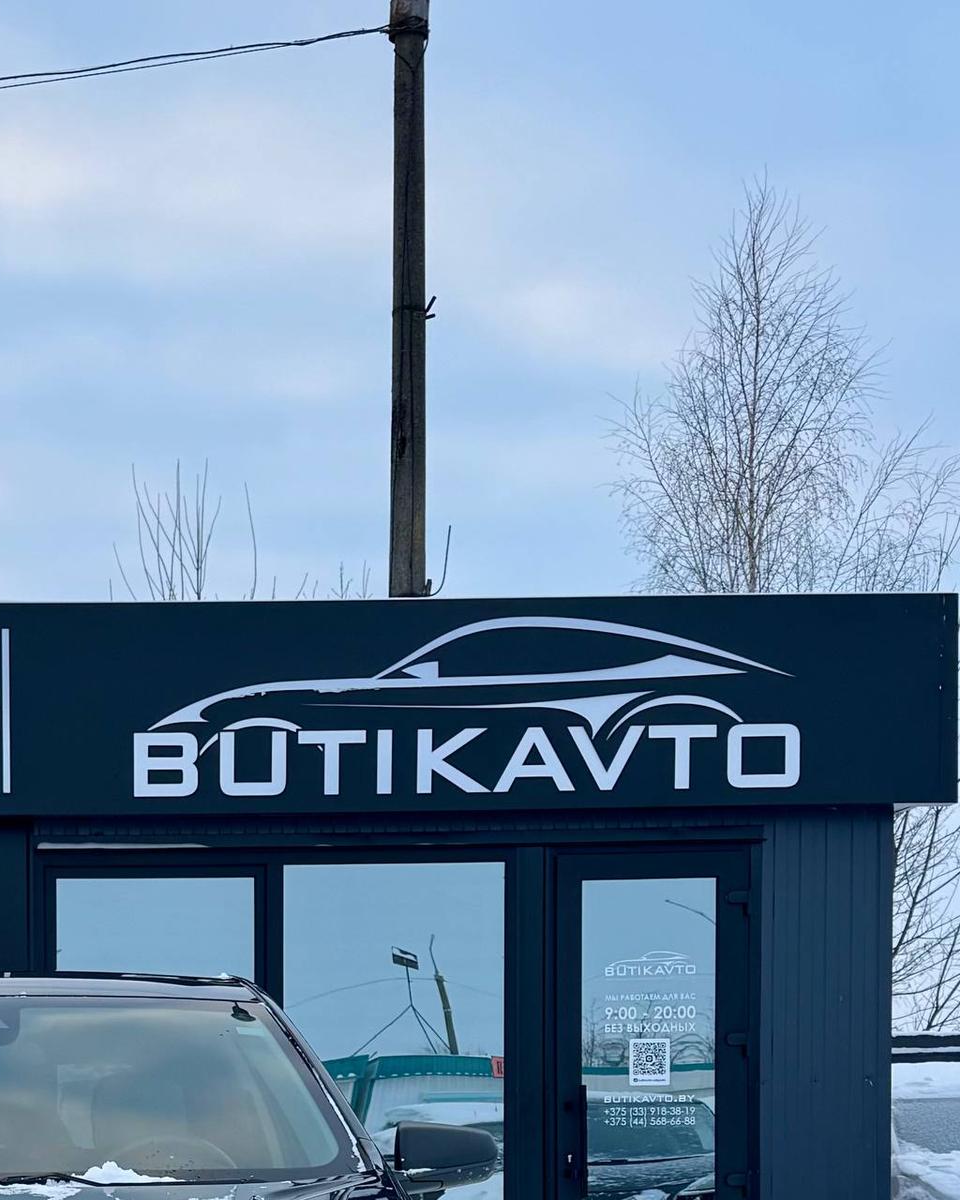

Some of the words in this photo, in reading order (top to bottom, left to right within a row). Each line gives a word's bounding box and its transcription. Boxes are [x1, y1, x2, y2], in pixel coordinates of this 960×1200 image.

[133, 723, 801, 798] BUTIKAVTO
[605, 965, 696, 976] BUTIKAVTO
[605, 1007, 637, 1020] 9:00
[653, 1005, 696, 1019] 20:00
[604, 1023, 623, 1033] БЕЗ
[627, 1022, 696, 1033] ВЫХОДНЫХ
[604, 1094, 695, 1103] BUTIKAVTO.BY
[604, 1107, 627, 1116] +375
[629, 1107, 647, 1118] (33)
[649, 1106, 696, 1116] 918-38-19
[604, 1117, 627, 1126] +375
[629, 1117, 647, 1128] (44)
[649, 1116, 696, 1126] 568-66-88
